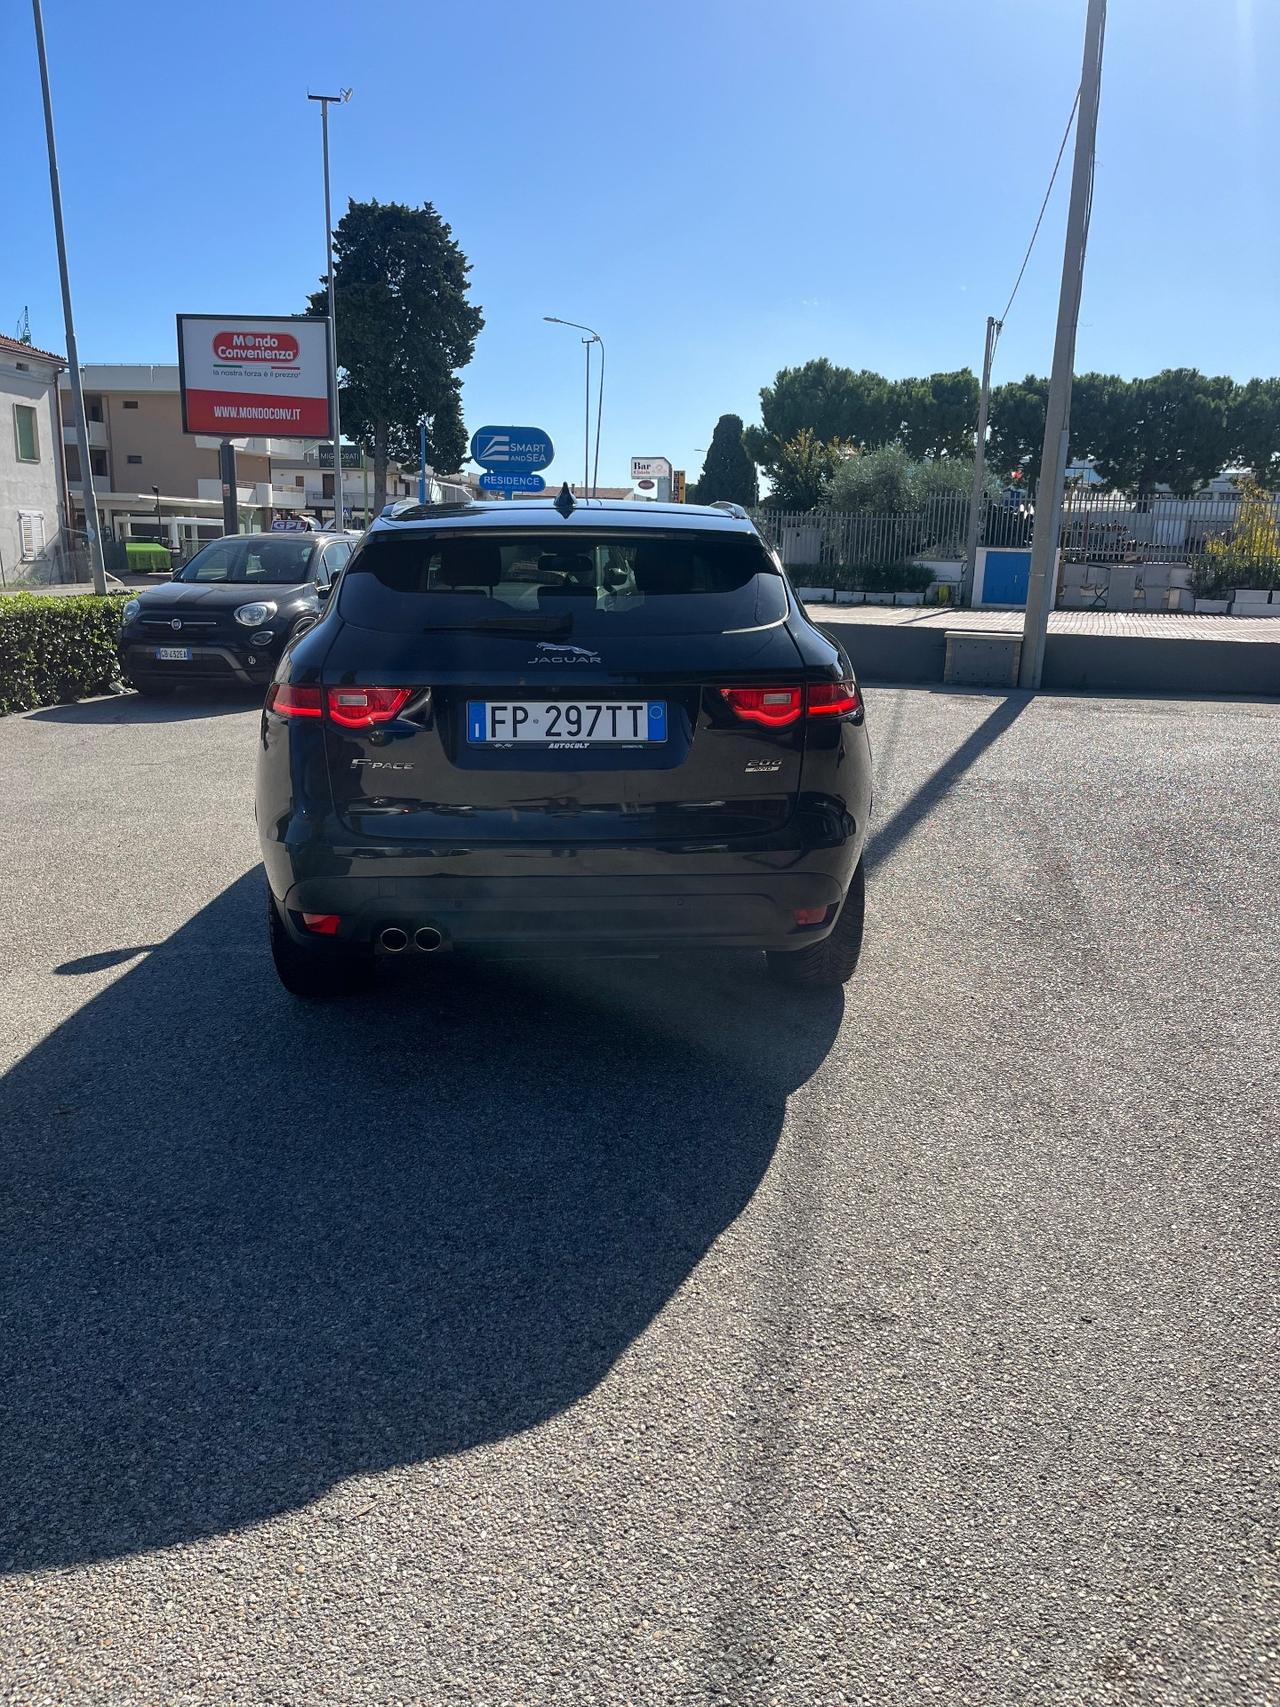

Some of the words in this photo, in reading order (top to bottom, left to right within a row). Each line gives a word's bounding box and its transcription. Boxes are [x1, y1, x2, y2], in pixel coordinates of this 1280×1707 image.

[232, 335, 278, 347] Mondo
[218, 346, 294, 360] Convenienza
[213, 406, 301, 420] WWW.MONDOCONV.IT
[510, 443, 546, 453] SMART
[526, 453, 546, 462] SEA
[634, 462, 651, 470] Bar
[483, 475, 540, 486] RESIDENCE
[273, 521, 306, 530] GPL
[490, 706, 529, 738] FP
[545, 705, 644, 738] 297TT
